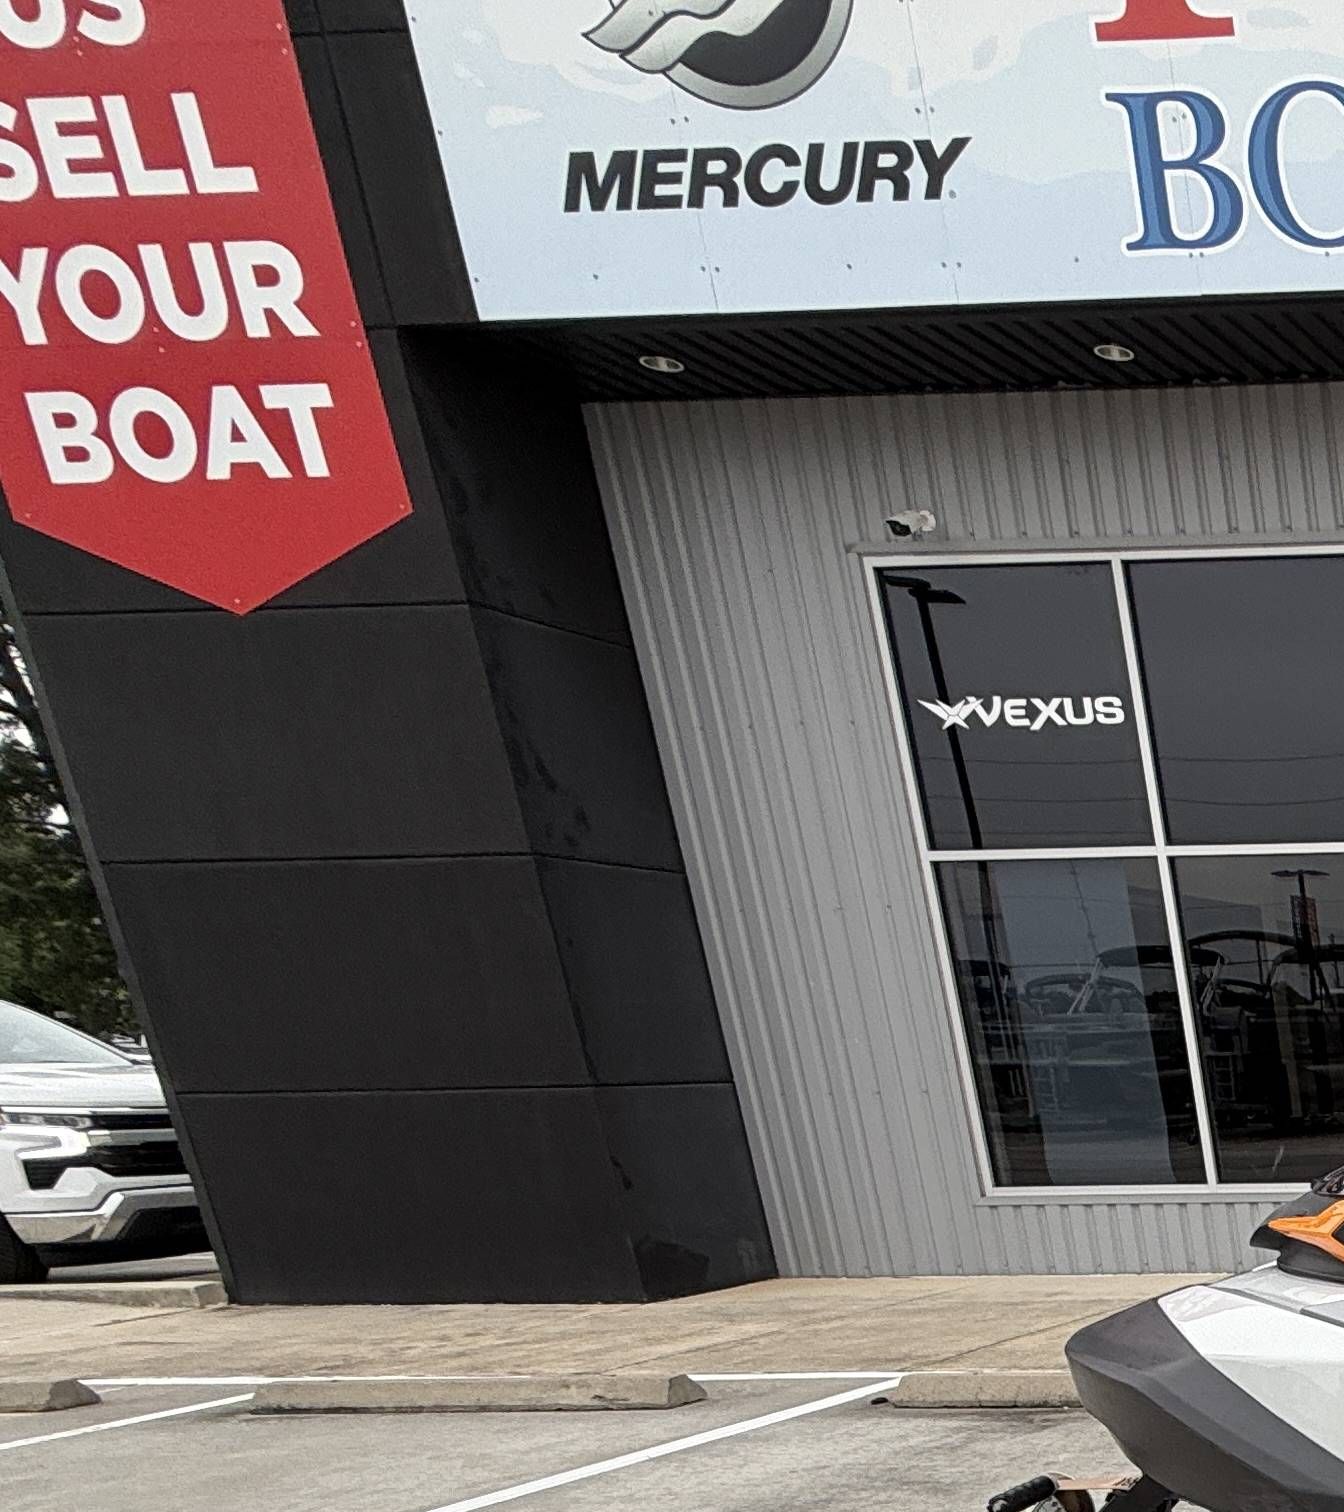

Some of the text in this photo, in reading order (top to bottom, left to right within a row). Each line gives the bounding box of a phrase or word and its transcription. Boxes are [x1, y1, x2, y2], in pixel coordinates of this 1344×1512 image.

[564, 137, 972, 213] MERCURY
[0, 240, 321, 346] YOUR
[24, 383, 334, 484] BOAT
[966, 695, 1125, 731] VEXUS
